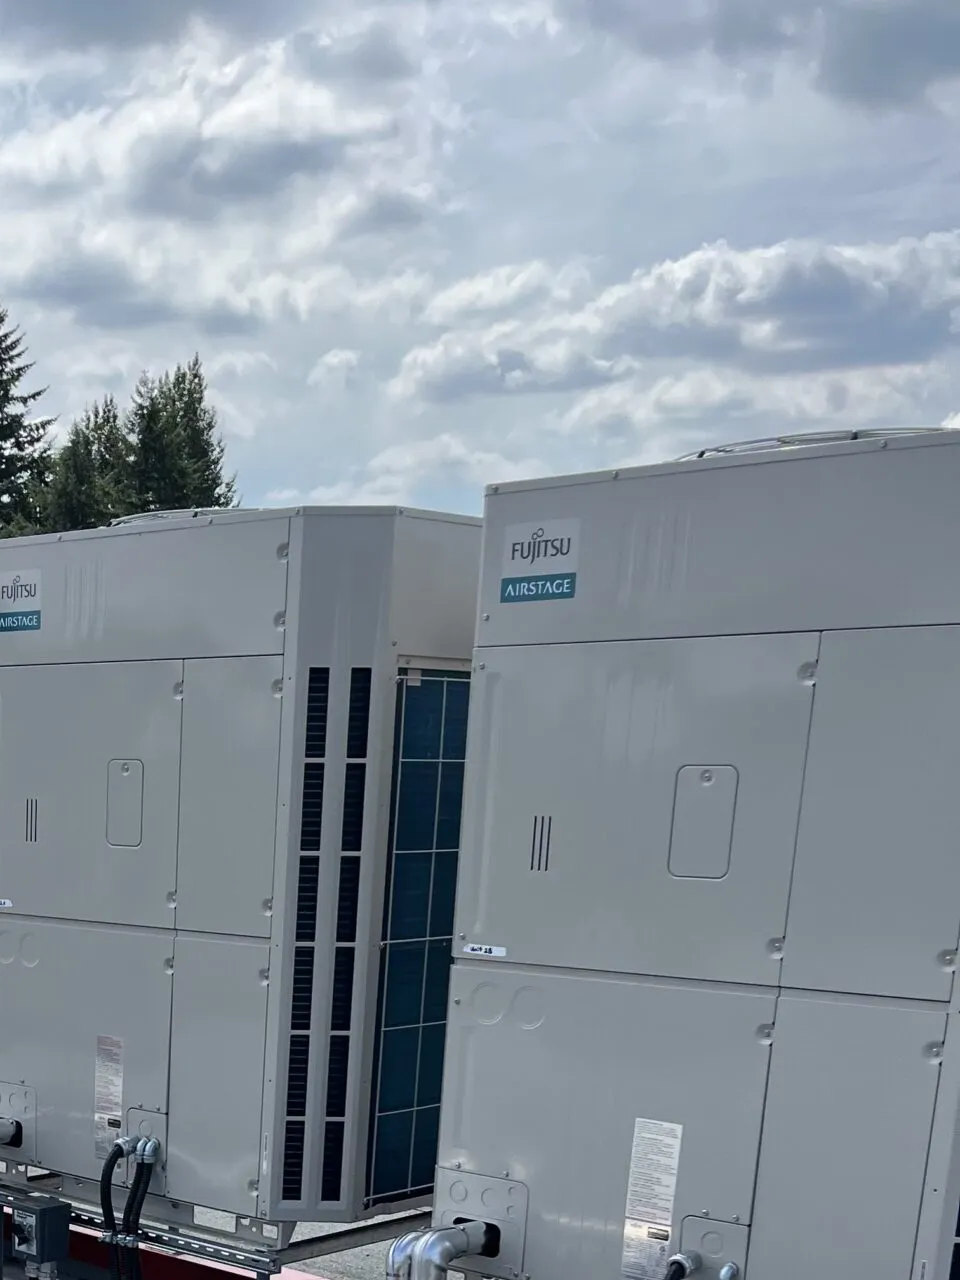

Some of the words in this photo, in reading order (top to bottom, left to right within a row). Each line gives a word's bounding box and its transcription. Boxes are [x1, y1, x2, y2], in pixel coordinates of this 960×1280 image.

[511, 528, 571, 565] FUJITSU
[1, 575, 37, 604] FUJITSU
[505, 579, 571, 597] AIRSTAGE
[0, 615, 38, 628] AIRSTAGE
